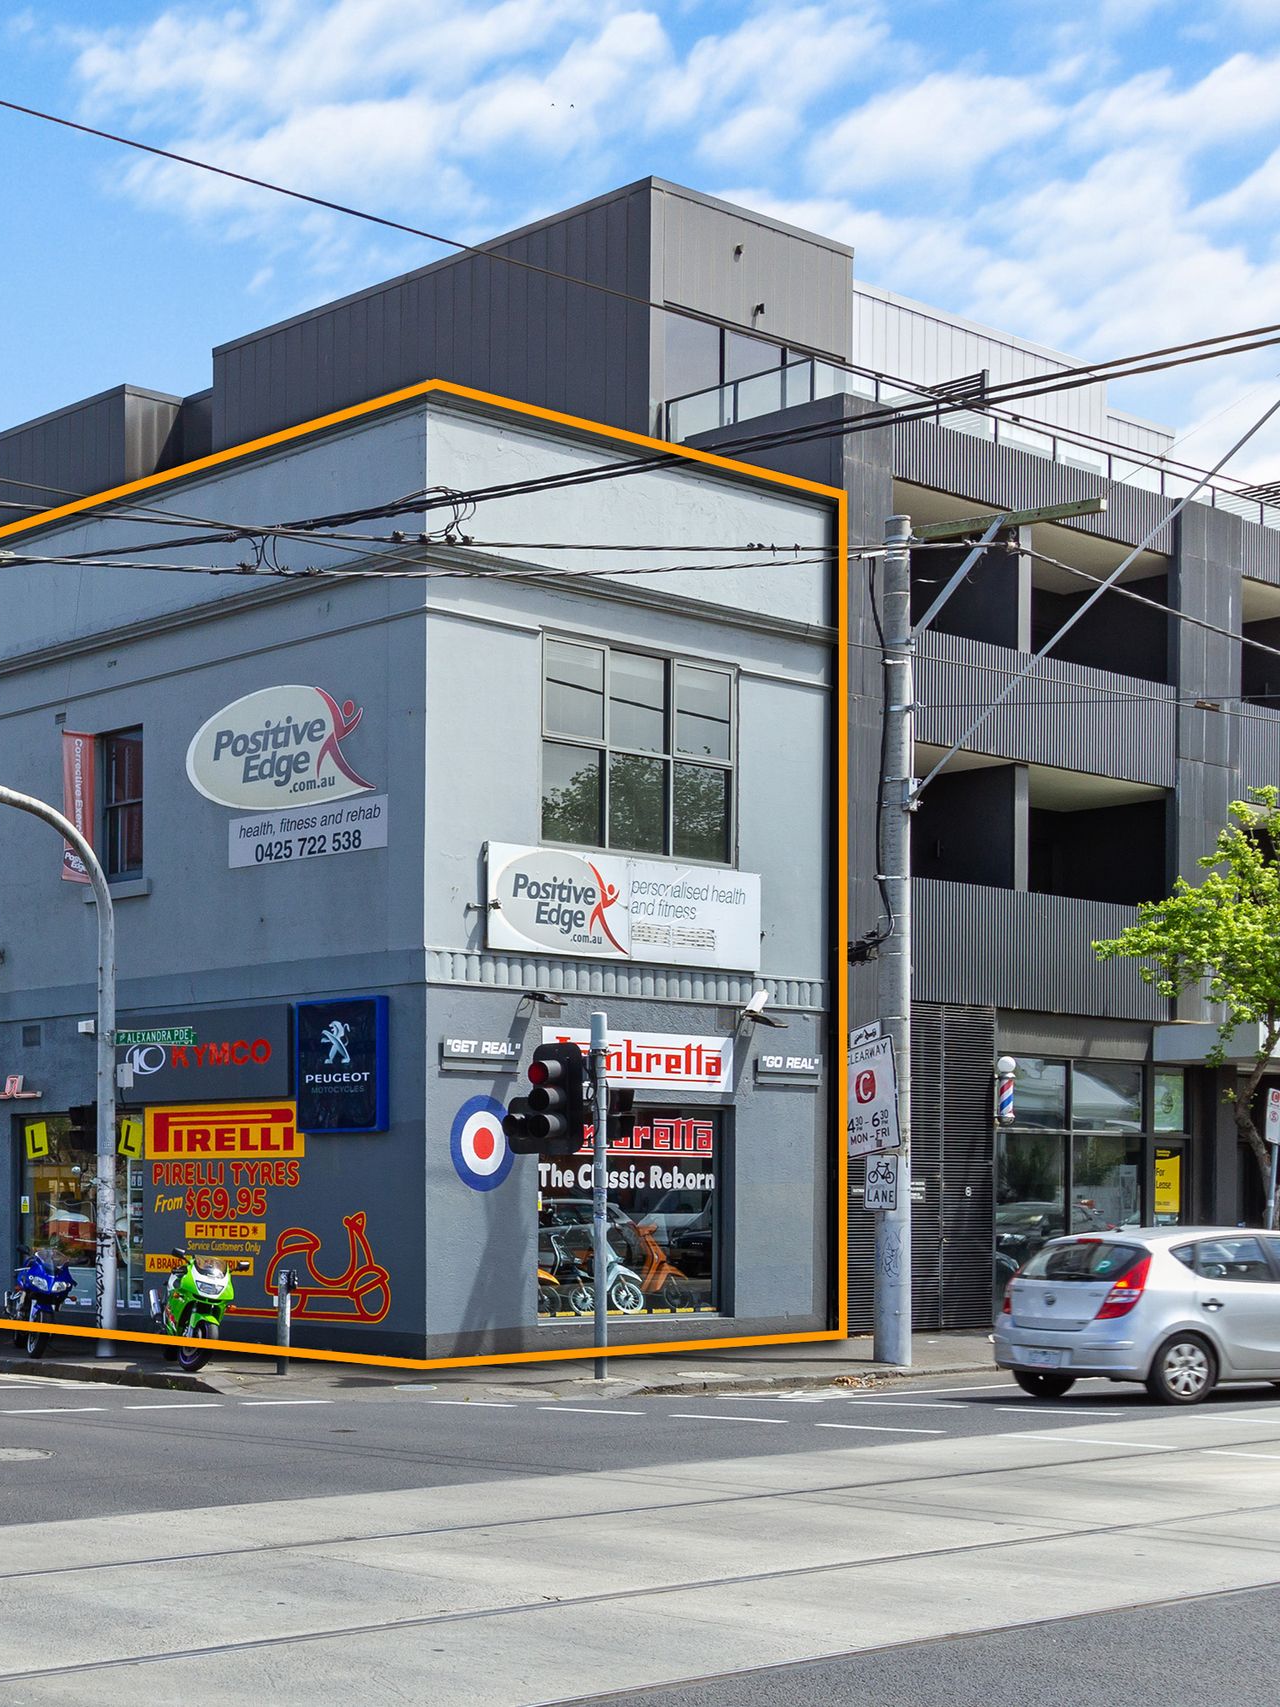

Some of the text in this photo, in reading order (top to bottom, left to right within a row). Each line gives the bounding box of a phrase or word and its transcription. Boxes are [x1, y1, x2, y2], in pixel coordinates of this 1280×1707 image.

[213, 715, 326, 761] Positive
[74, 739, 83, 797] Corrective
[242, 751, 310, 787] Edge
[289, 775, 335, 793] .com.au
[238, 803, 381, 840] health, fitness and rehab
[255, 829, 362, 863] 0425 722 538
[512, 873, 596, 906] Positive
[631, 879, 746, 905] personalised health
[535, 902, 585, 934] Edge
[631, 899, 697, 920] and fitness
[570, 934, 602, 945] .com.au
[127, 1028, 189, 1043] ALEXANDRA PDE
[171, 1038, 271, 1068] KYMCO
[848, 1042, 888, 1066] LEARWAY
[305, 1071, 370, 1084] PEUGEOT
[311, 1085, 365, 1094] MOTOCYCLES
[31, 1131, 43, 1152] L
[154, 1108, 294, 1152] PIRELLI
[152, 1160, 301, 1187] PIRELLI TYRES
[538, 1162, 716, 1190] The Cssic Reborn
[154, 1187, 268, 1221] From $69.95
[867, 1190, 894, 1203] LANE
[187, 1241, 261, 1255] Service Customers Only
[149, 1258, 156, 1269] A
